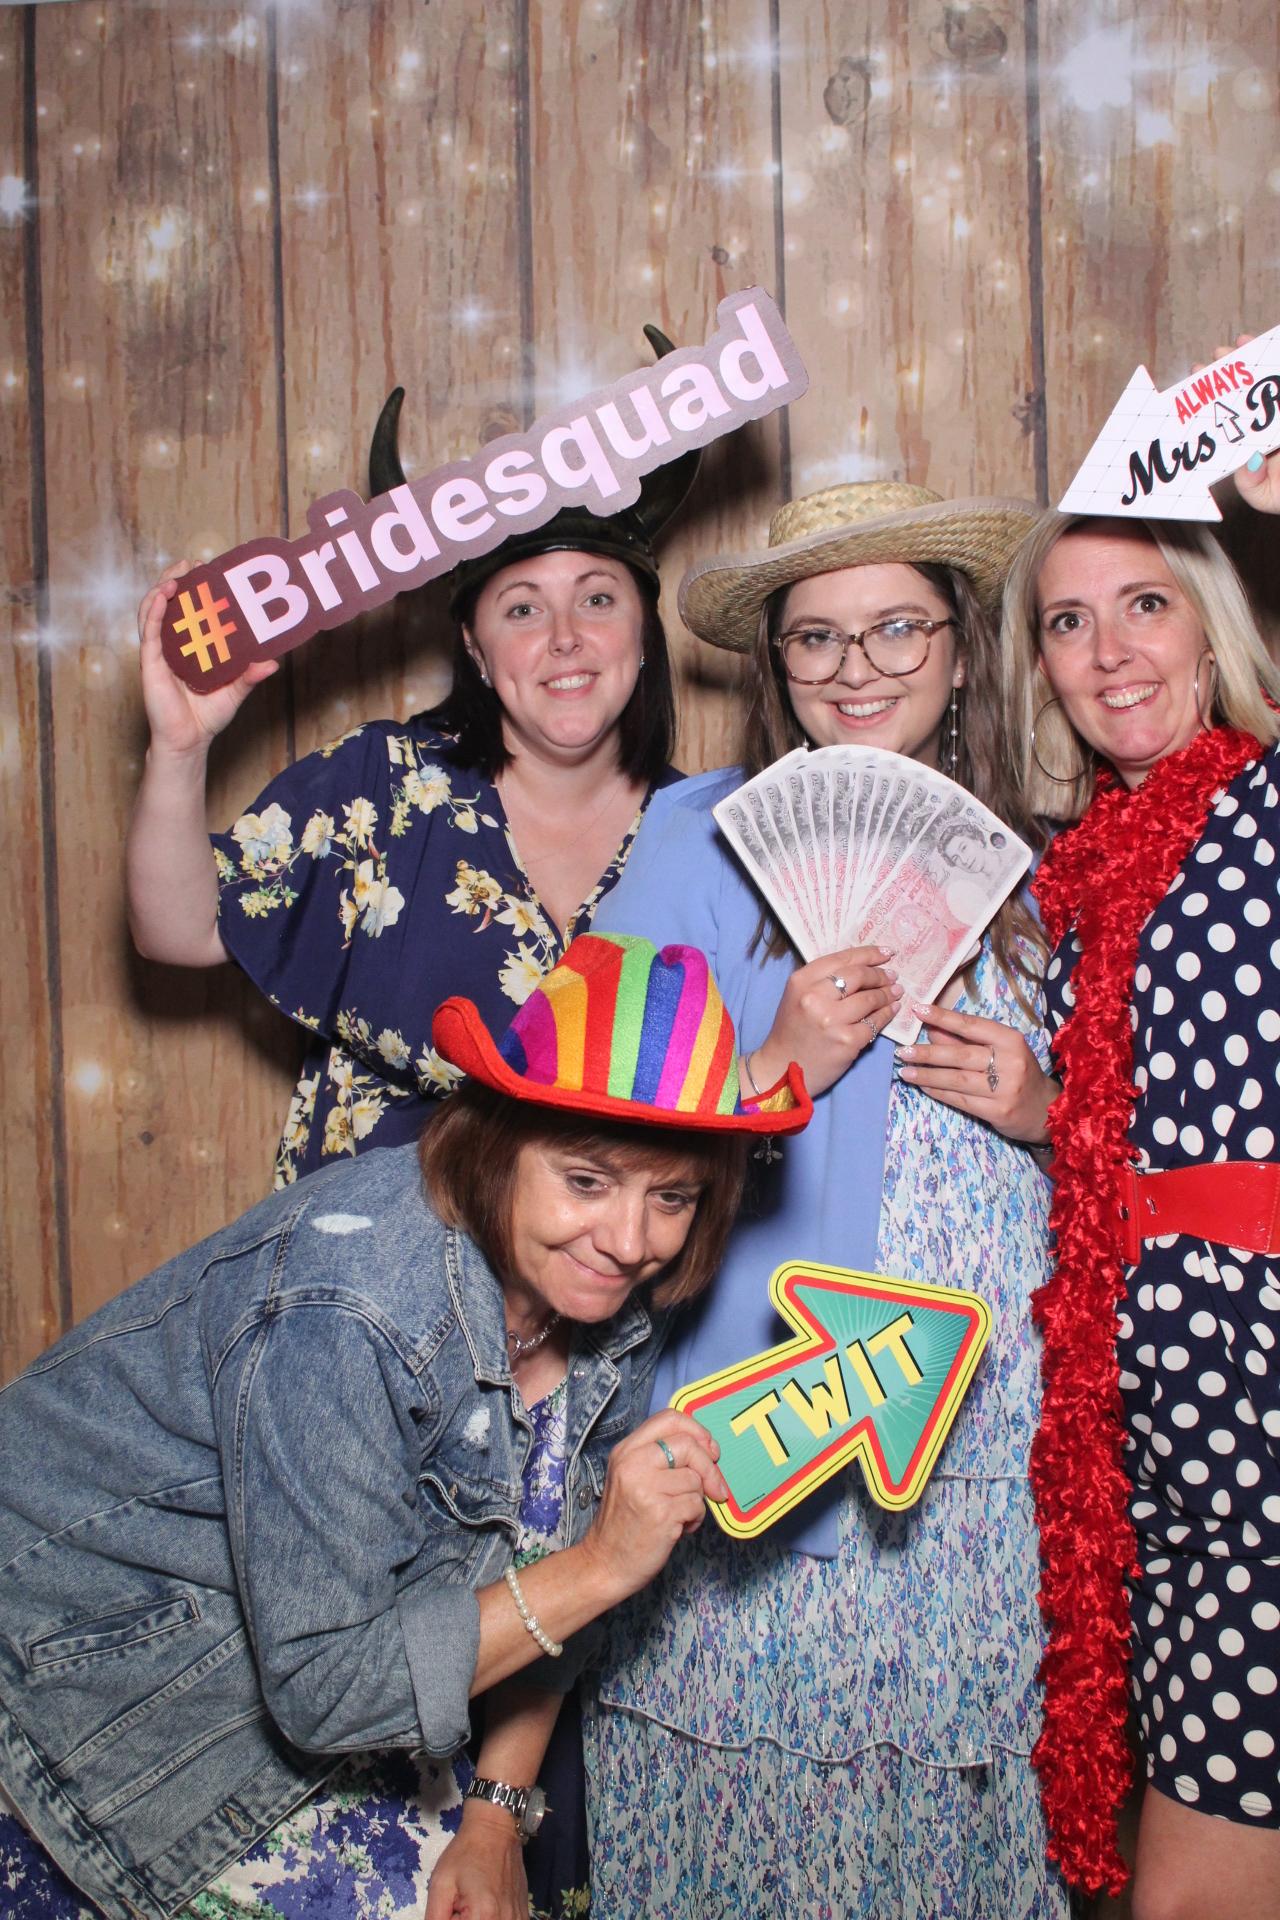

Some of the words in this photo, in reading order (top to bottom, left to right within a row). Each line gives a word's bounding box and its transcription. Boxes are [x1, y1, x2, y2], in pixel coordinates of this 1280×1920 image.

[1175, 361, 1254, 424] ALWAYS
[172, 303, 790, 673] #Bridesquad
[1121, 431, 1216, 505] Mrs
[729, 1310, 924, 1467] TWIT
